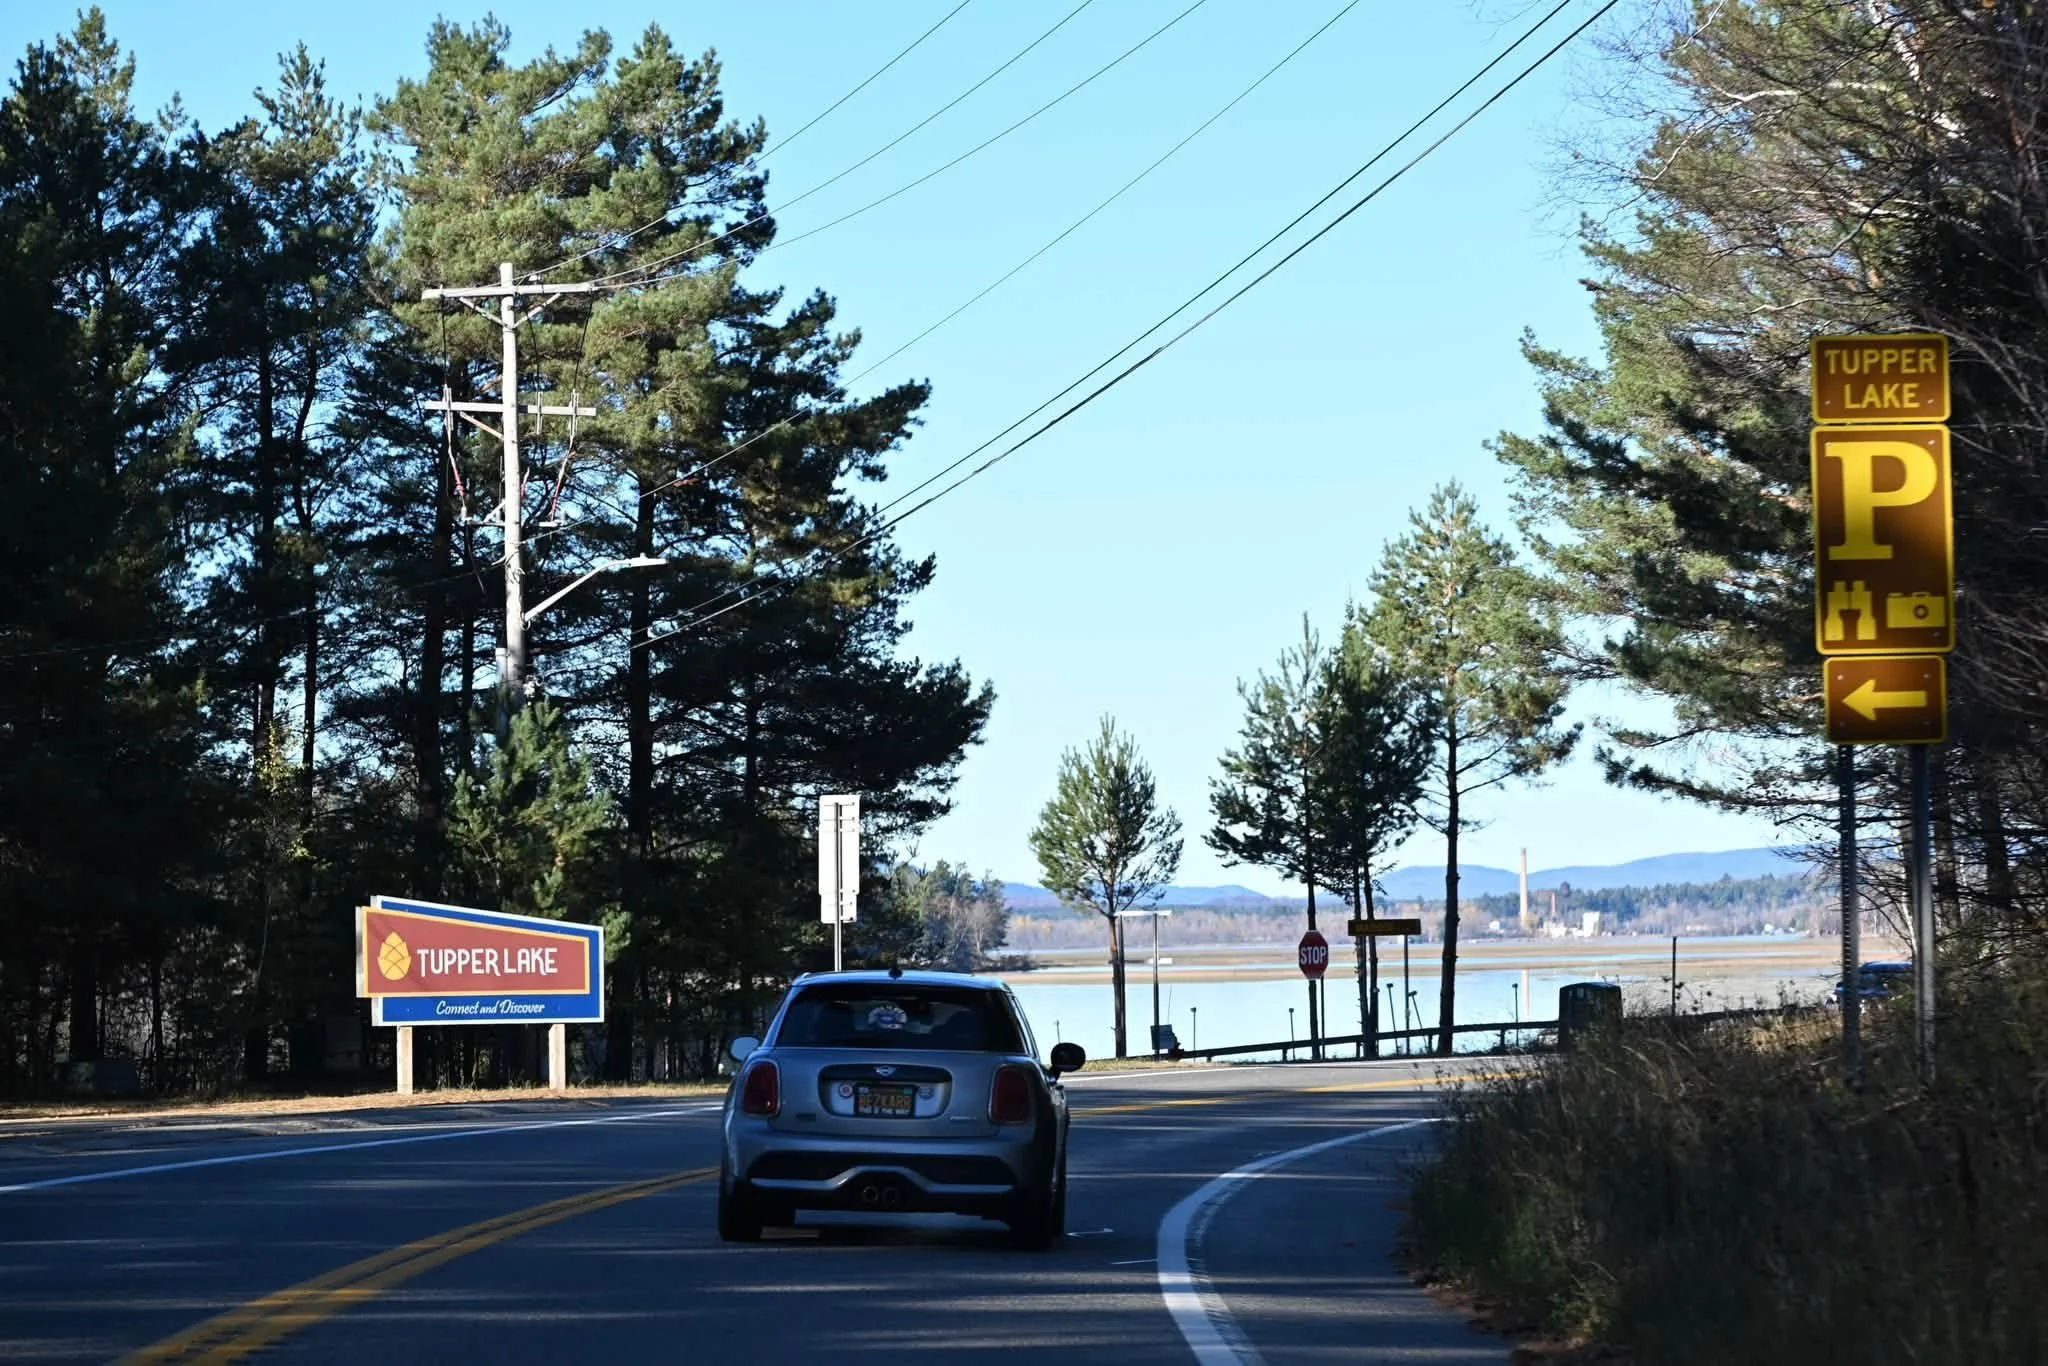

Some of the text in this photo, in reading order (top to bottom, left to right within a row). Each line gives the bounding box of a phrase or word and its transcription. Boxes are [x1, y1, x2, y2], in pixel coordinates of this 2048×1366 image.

[1824, 349, 1937, 375] TUPPER
[1844, 383, 1920, 409] LAKE
[1824, 441, 1938, 561] P
[417, 947, 558, 977] TUPPER LAKE
[1300, 946, 1327, 965] STOP
[436, 999, 546, 1015] Connect and Discover
